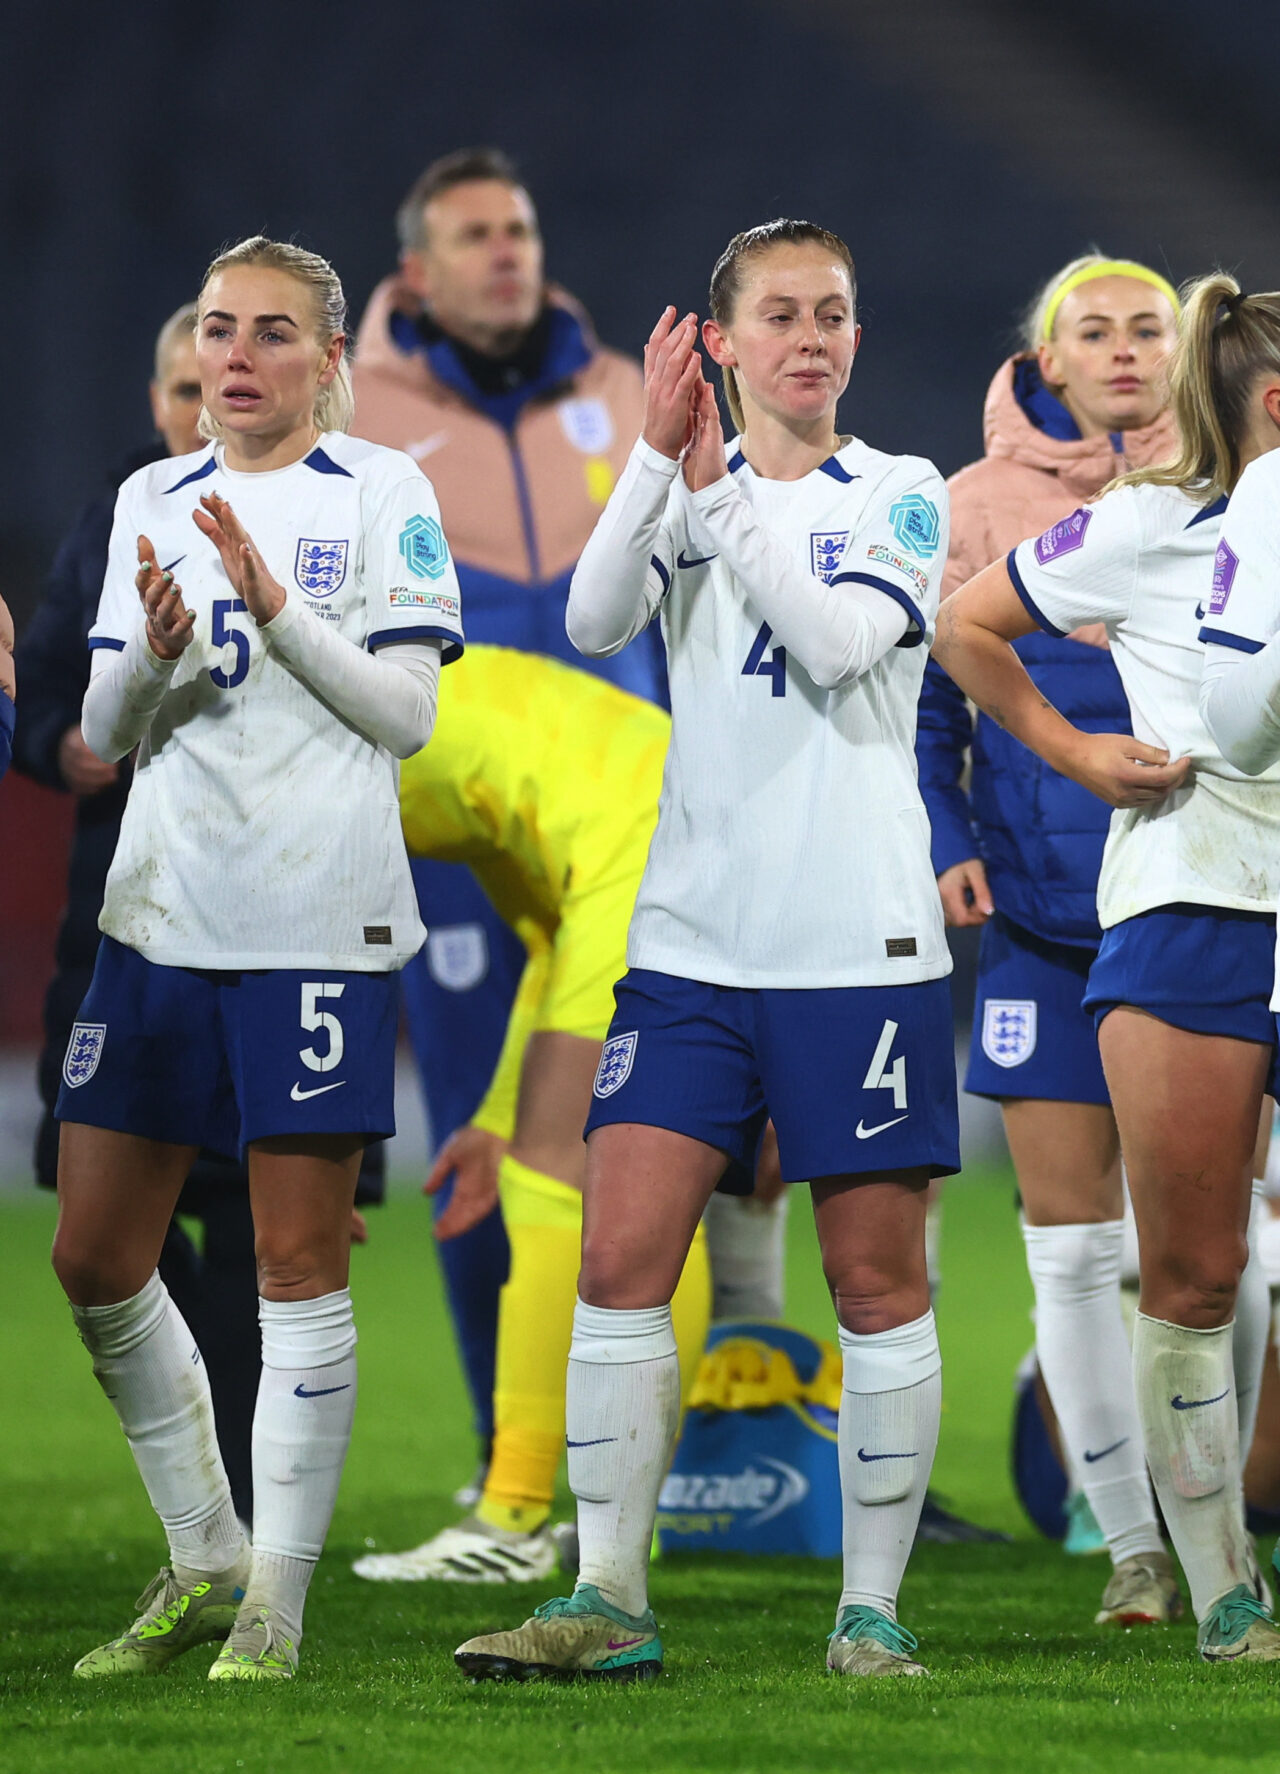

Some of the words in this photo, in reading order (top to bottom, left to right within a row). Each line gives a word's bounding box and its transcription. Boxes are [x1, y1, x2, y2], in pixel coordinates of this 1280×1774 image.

[867, 549, 928, 590] FOUNDATIO
[326, 613, 341, 621] 2023
[389, 593, 459, 611] FOUNDATION
[209, 599, 250, 689] 5
[741, 619, 787, 697] 4
[299, 982, 346, 1072] 5
[862, 1018, 908, 1109] 4
[655, 1512, 735, 1534] PORT
